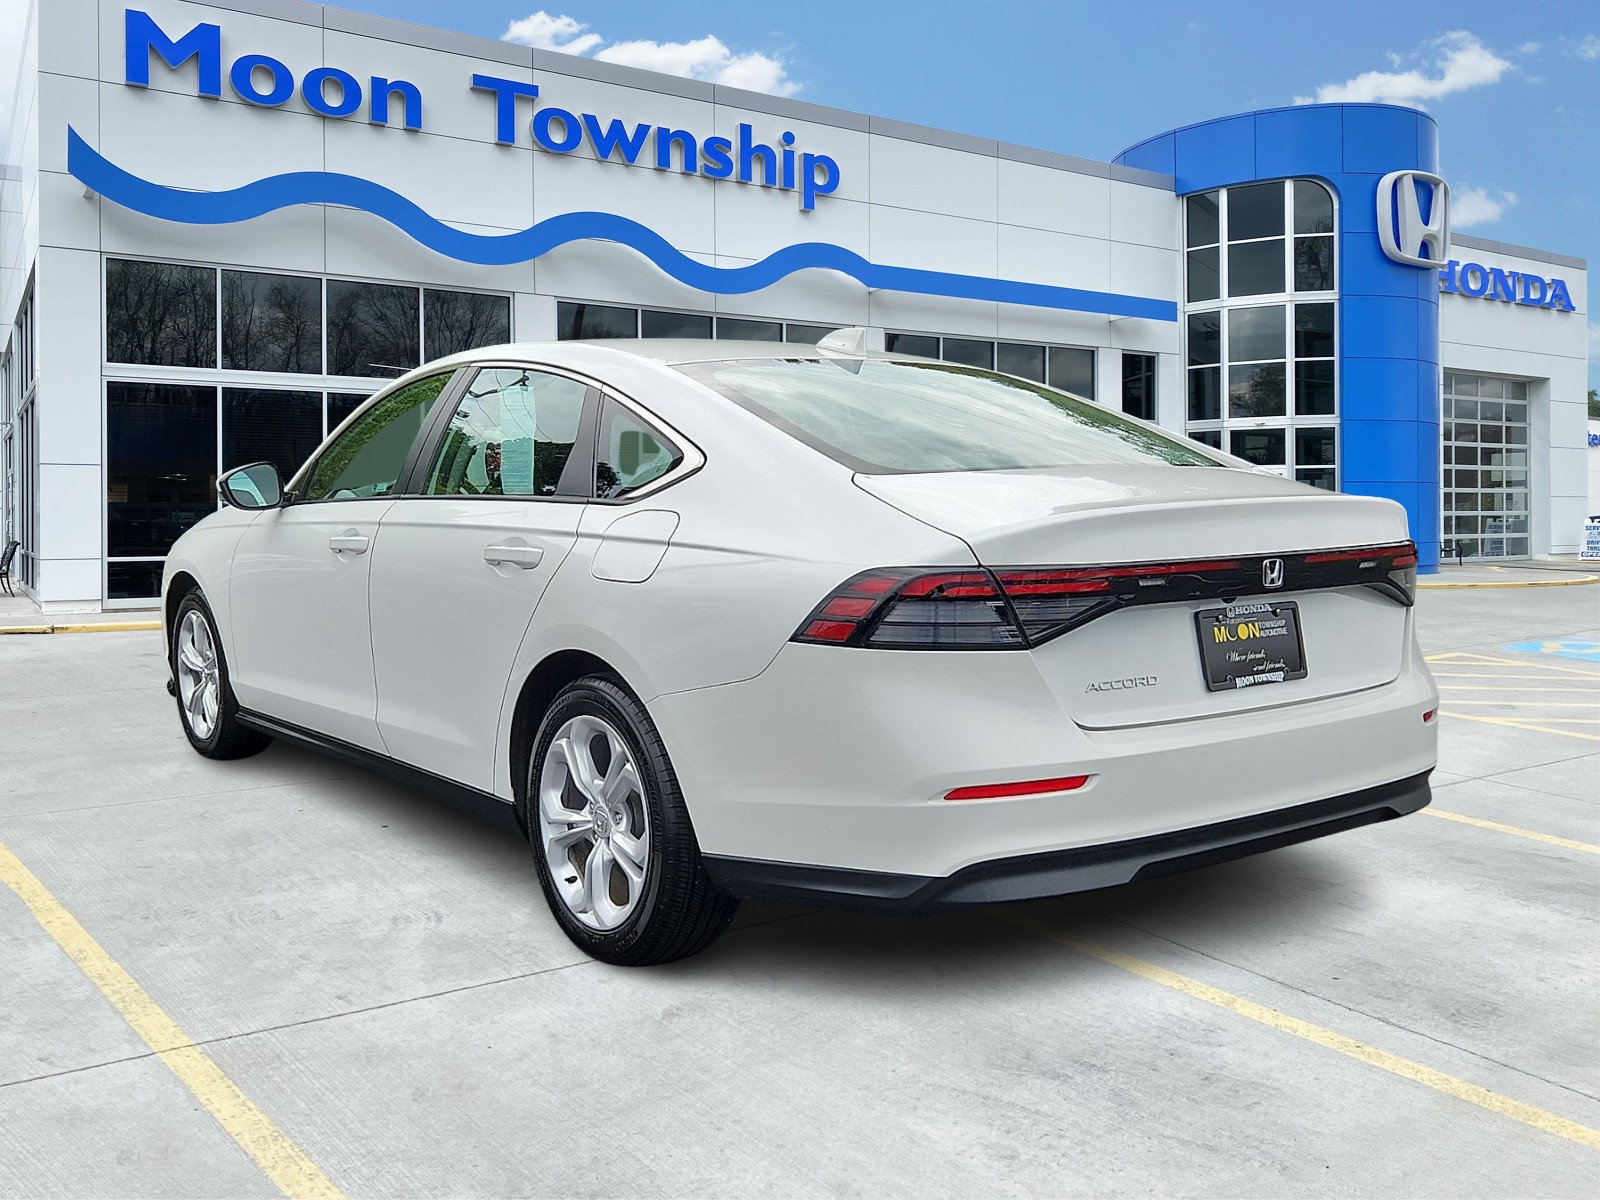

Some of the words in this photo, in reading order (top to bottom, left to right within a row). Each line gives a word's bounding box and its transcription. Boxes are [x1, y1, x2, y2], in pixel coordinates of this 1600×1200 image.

[124, 9, 422, 131] Moon
[470, 73, 841, 213] Township
[1438, 259, 1576, 312] HONDA
[1235, 603, 1273, 615] HONDA
[1085, 676, 1157, 693] ACCORD
[1236, 676, 1255, 689] MOON
[1254, 671, 1285, 683] TOWNSHIP
